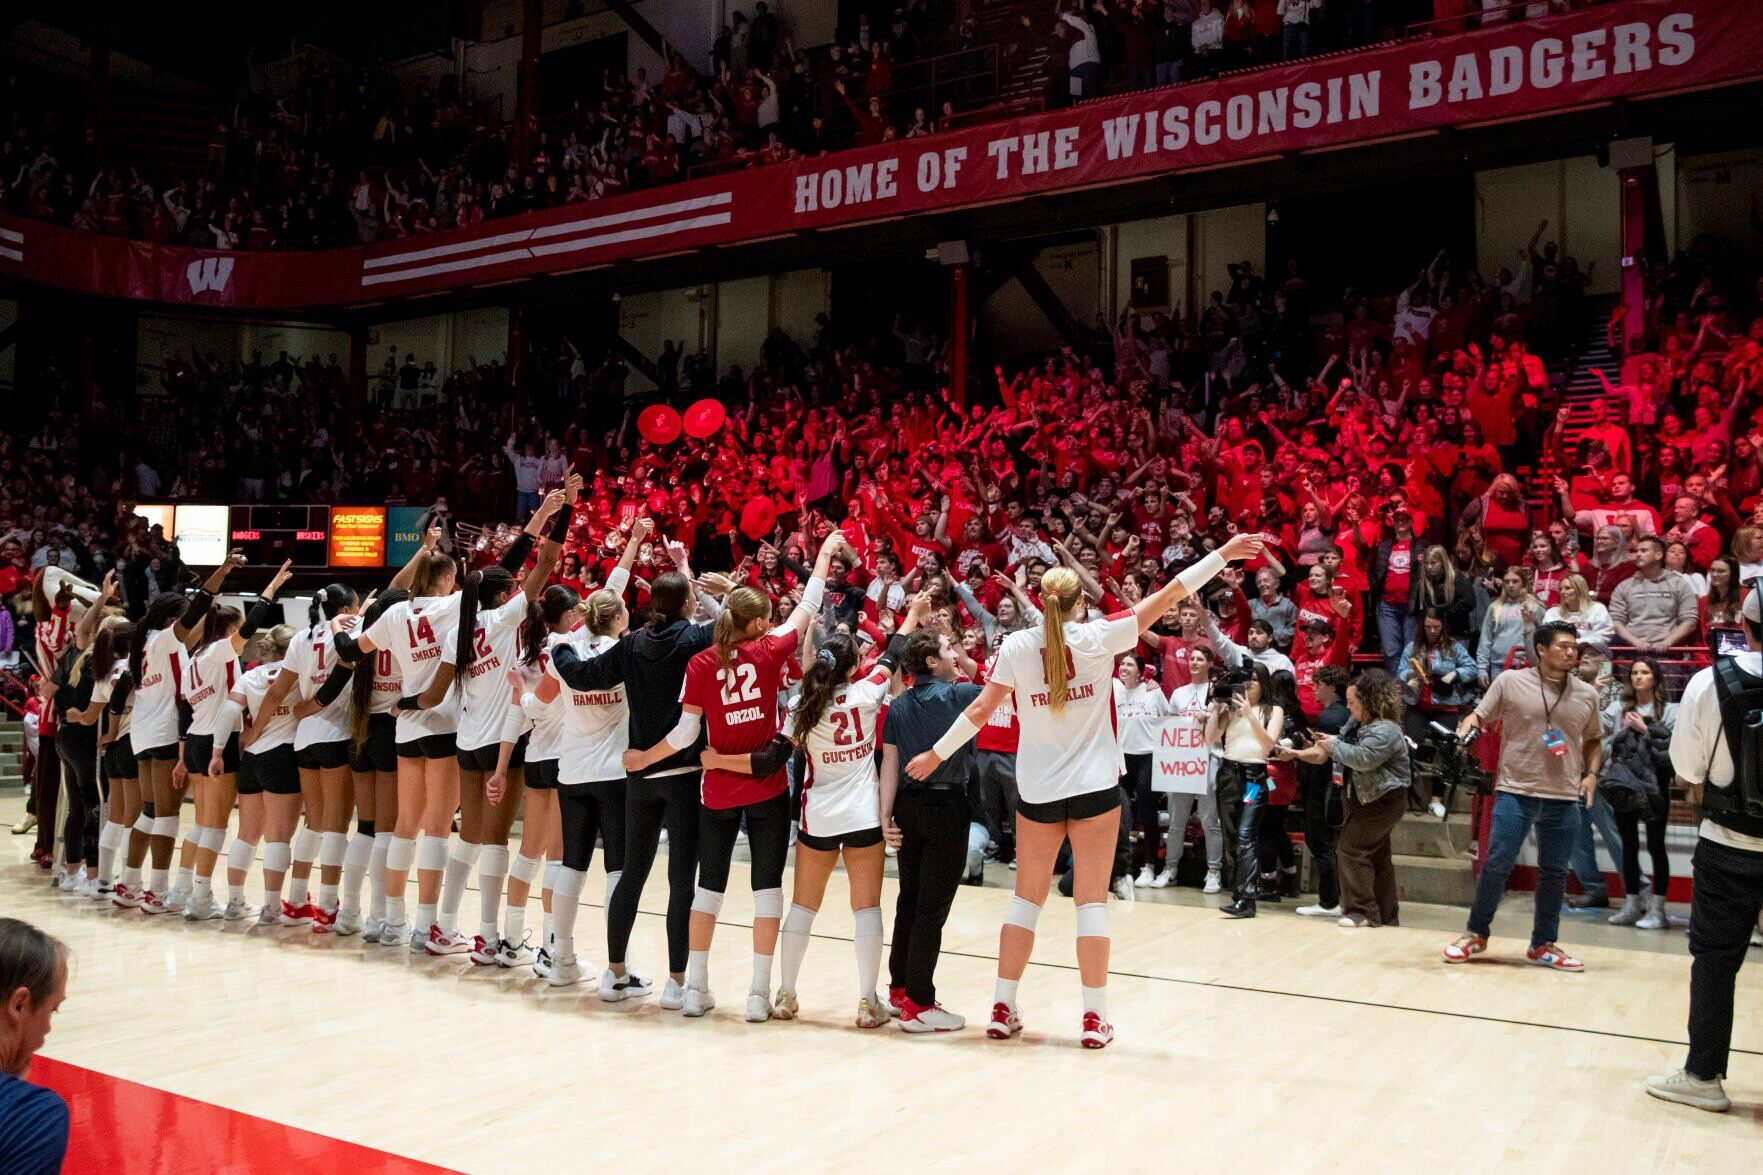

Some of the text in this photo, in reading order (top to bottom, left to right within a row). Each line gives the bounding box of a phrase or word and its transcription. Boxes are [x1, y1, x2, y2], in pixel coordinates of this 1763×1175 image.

[794, 12, 1696, 213] HOME OF THE WISCONSIN BADGERS
[186, 257, 235, 295] W
[333, 514, 383, 524] FASTSIGNS
[232, 531, 261, 541] BADGERS
[296, 531, 325, 541] HUSKERS
[395, 533, 420, 542] BMO
[406, 615, 437, 649] 14
[471, 627, 492, 661] 2
[313, 643, 326, 671] 7
[469, 656, 501, 679] BOOTH
[373, 681, 402, 692] INSON
[716, 663, 762, 706] 22
[1030, 684, 1094, 707] FRKLIN
[573, 692, 623, 706] HAMMILL
[725, 706, 765, 726] ORZOL
[829, 707, 865, 746] 21
[1160, 757, 1208, 776] WHO'S
